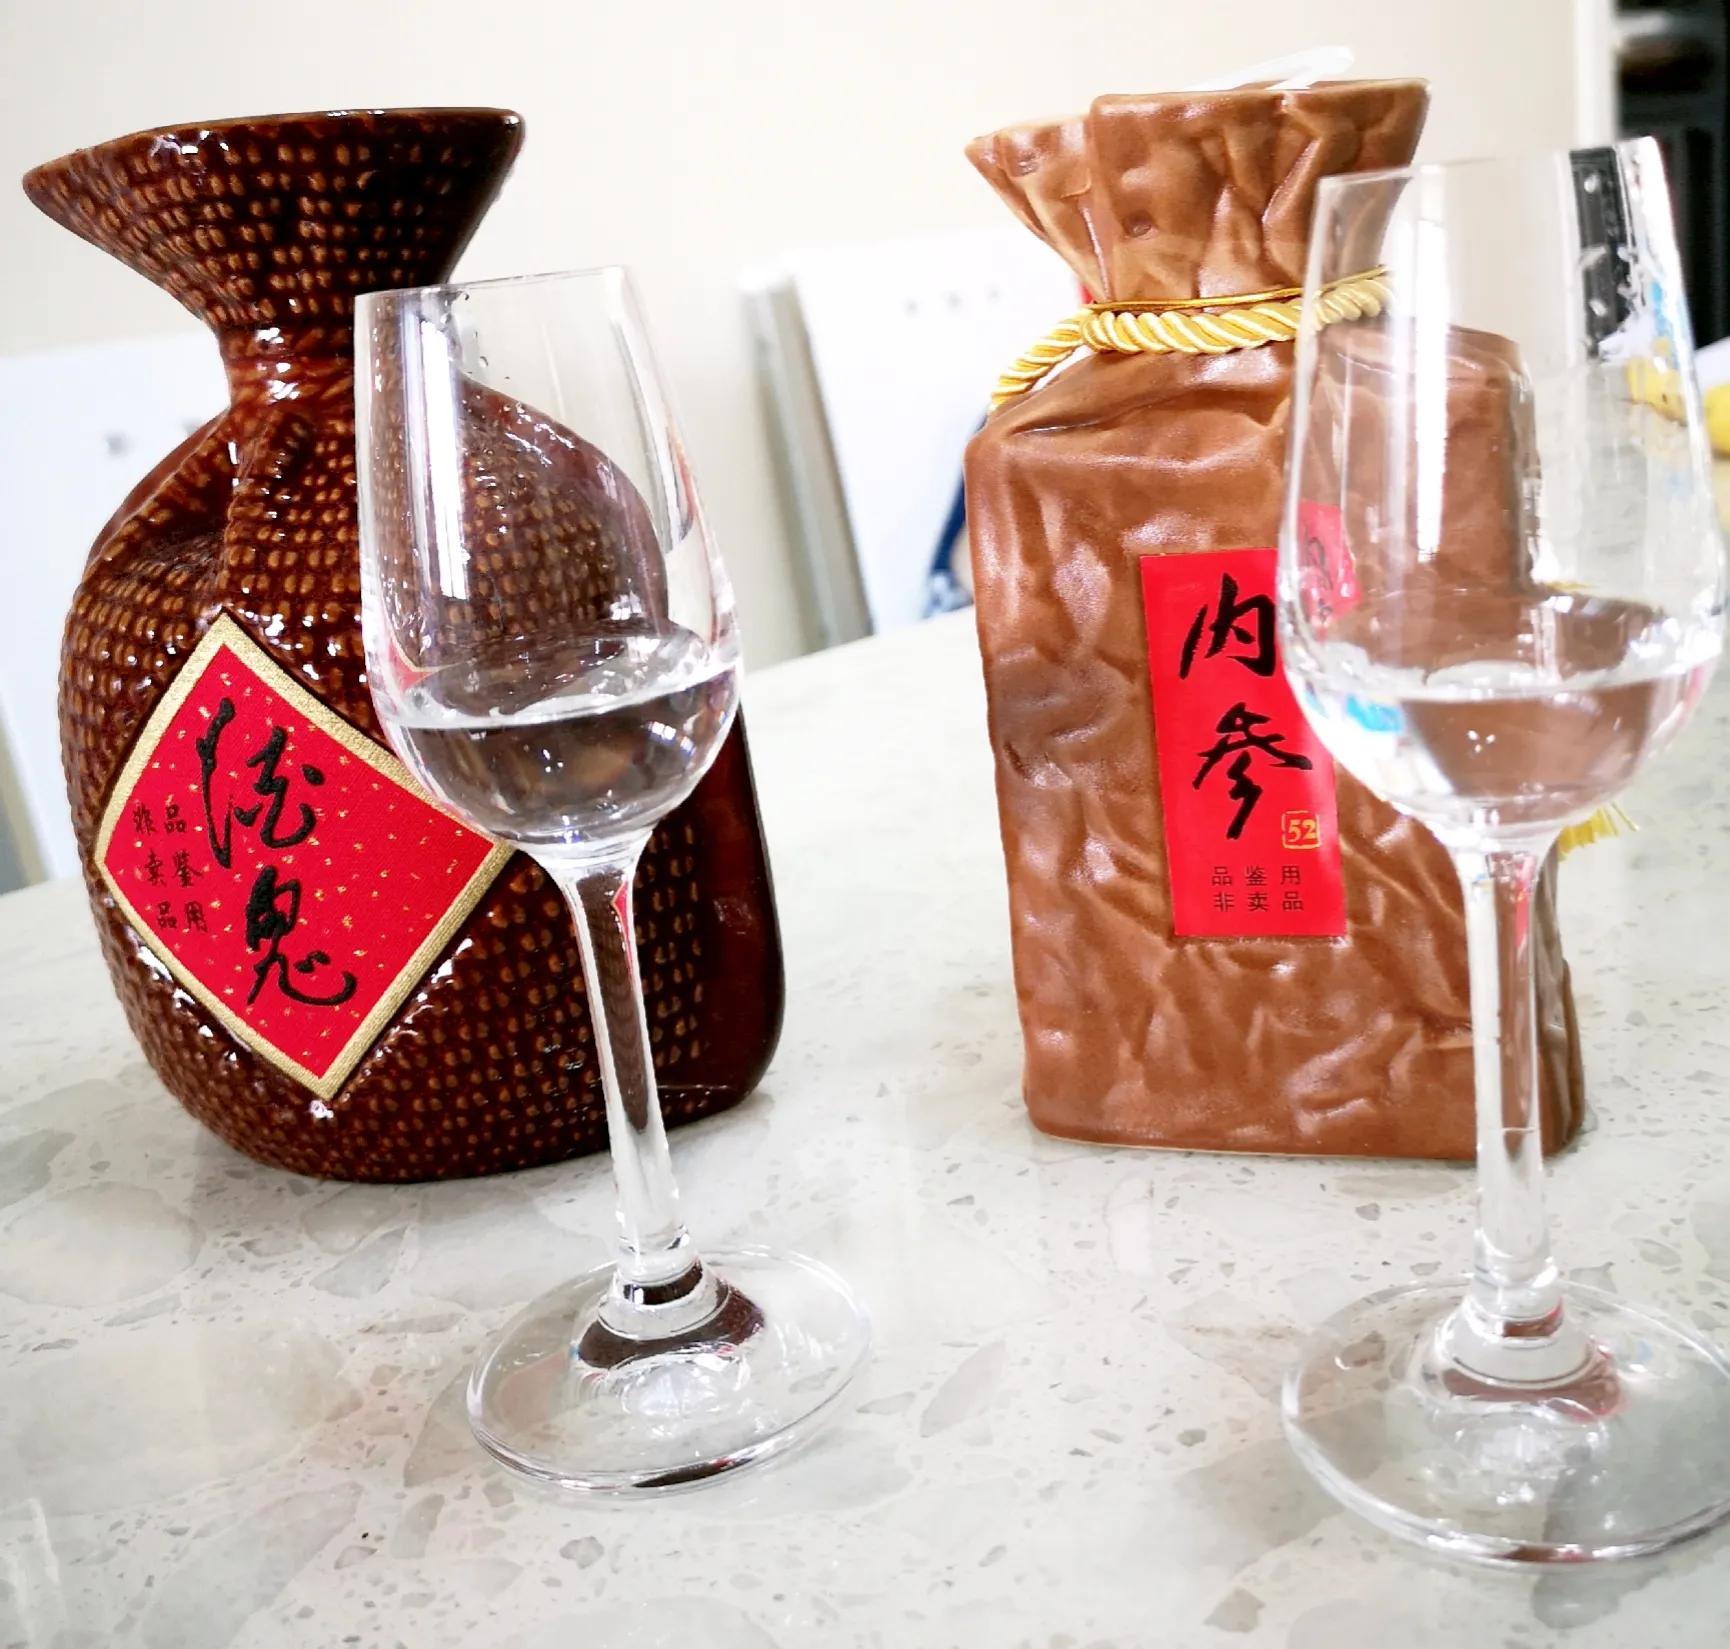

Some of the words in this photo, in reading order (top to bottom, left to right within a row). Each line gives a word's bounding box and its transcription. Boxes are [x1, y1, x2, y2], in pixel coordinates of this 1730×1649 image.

[1287, 818, 1317, 843] 52
[196, 697, 358, 1006] 酒鬼
[1211, 865, 1301, 887] 品鉴用
[1213, 891, 1304, 913] 非卖品
